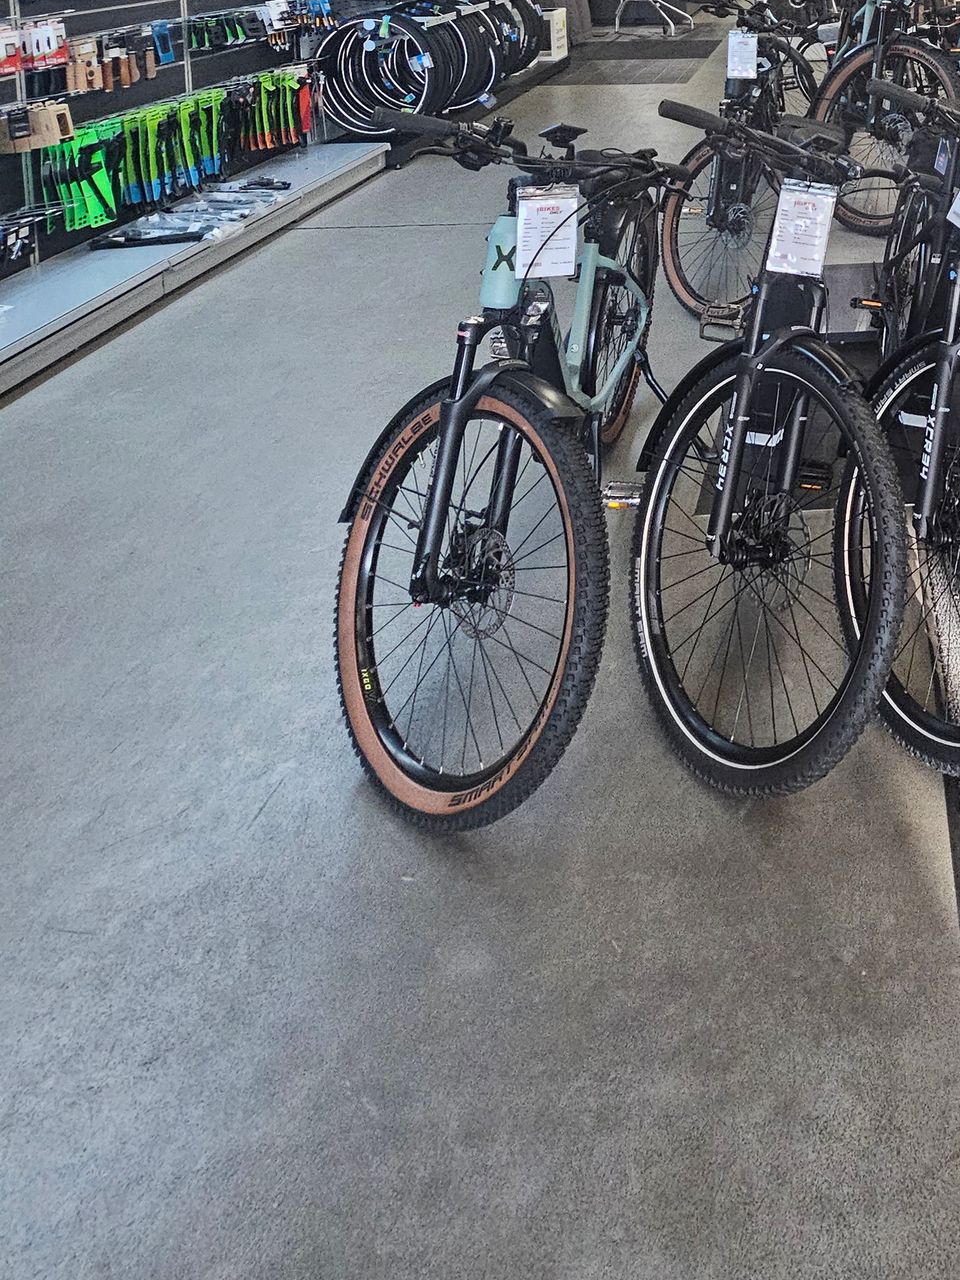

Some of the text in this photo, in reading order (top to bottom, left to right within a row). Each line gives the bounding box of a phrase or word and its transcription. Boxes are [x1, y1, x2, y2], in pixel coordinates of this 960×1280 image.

[360, 413, 433, 522] SCHWALBE
[715, 423, 735, 492] XCR34
[919, 414, 937, 481] XCR34
[447, 762, 512, 808] SMART
